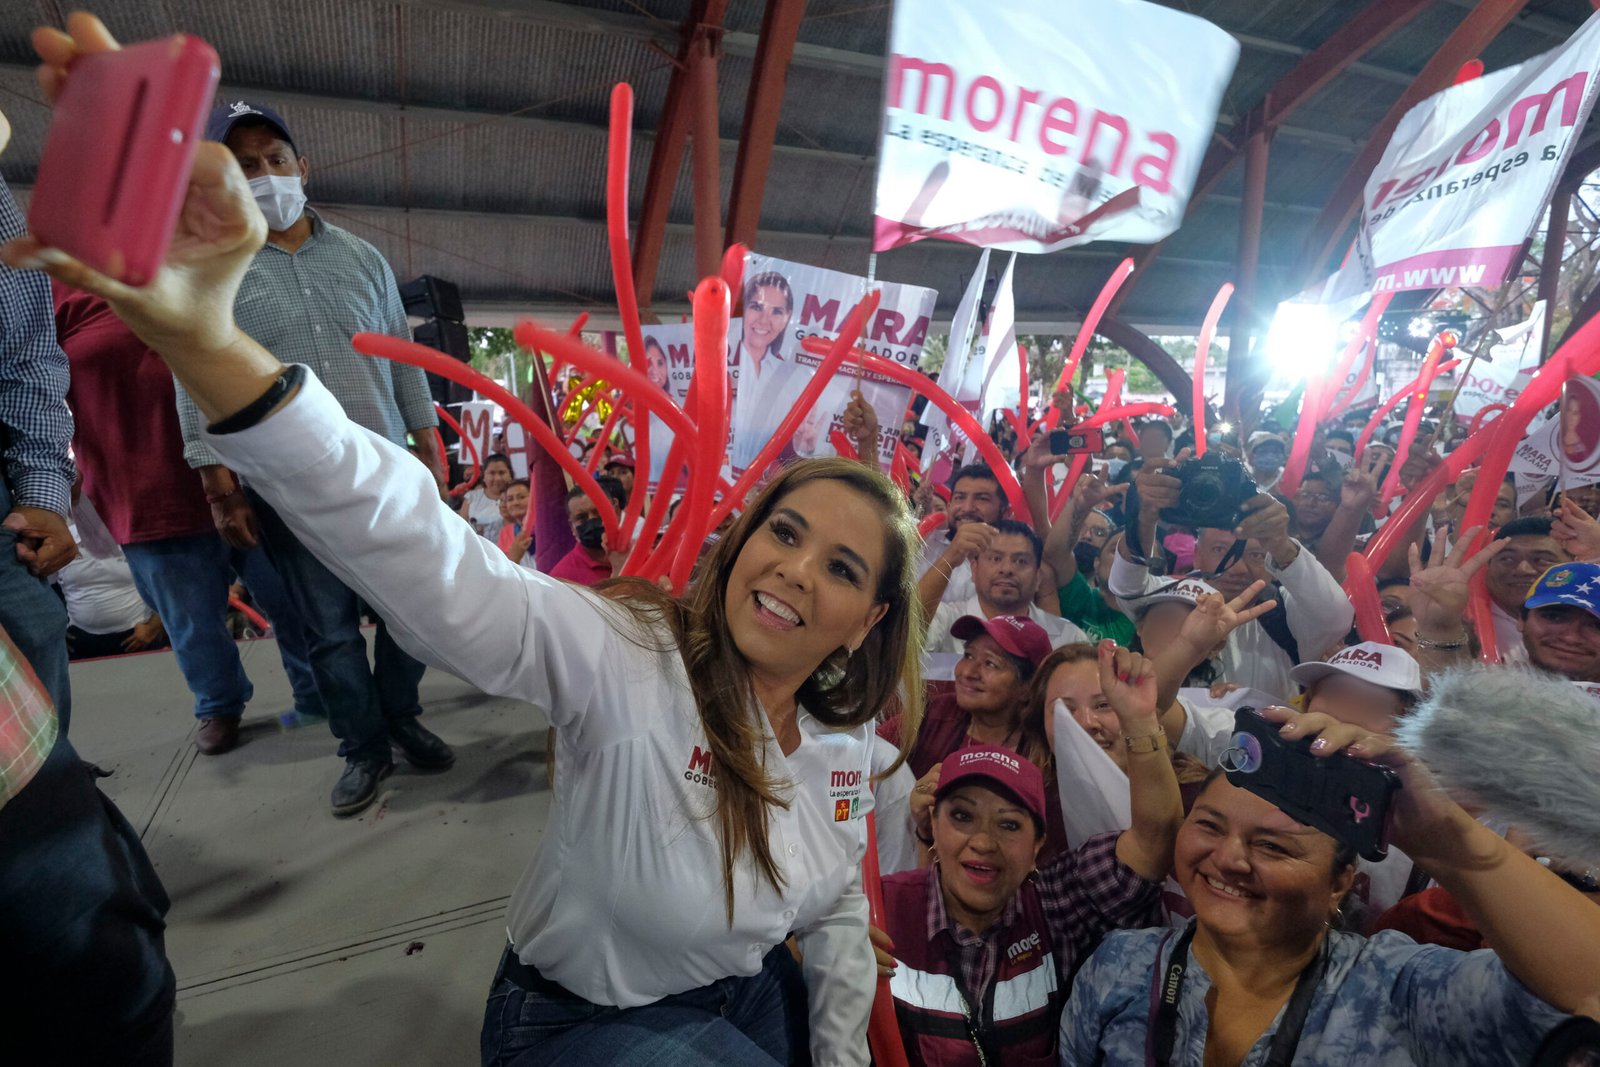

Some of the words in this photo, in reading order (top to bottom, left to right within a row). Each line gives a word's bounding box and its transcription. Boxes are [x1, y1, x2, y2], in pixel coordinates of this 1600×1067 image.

[888, 53, 1179, 194] morena
[1519, 443, 1553, 467] MARA
[960, 751, 1020, 770] morena
[1164, 963, 1183, 1005] Canon
